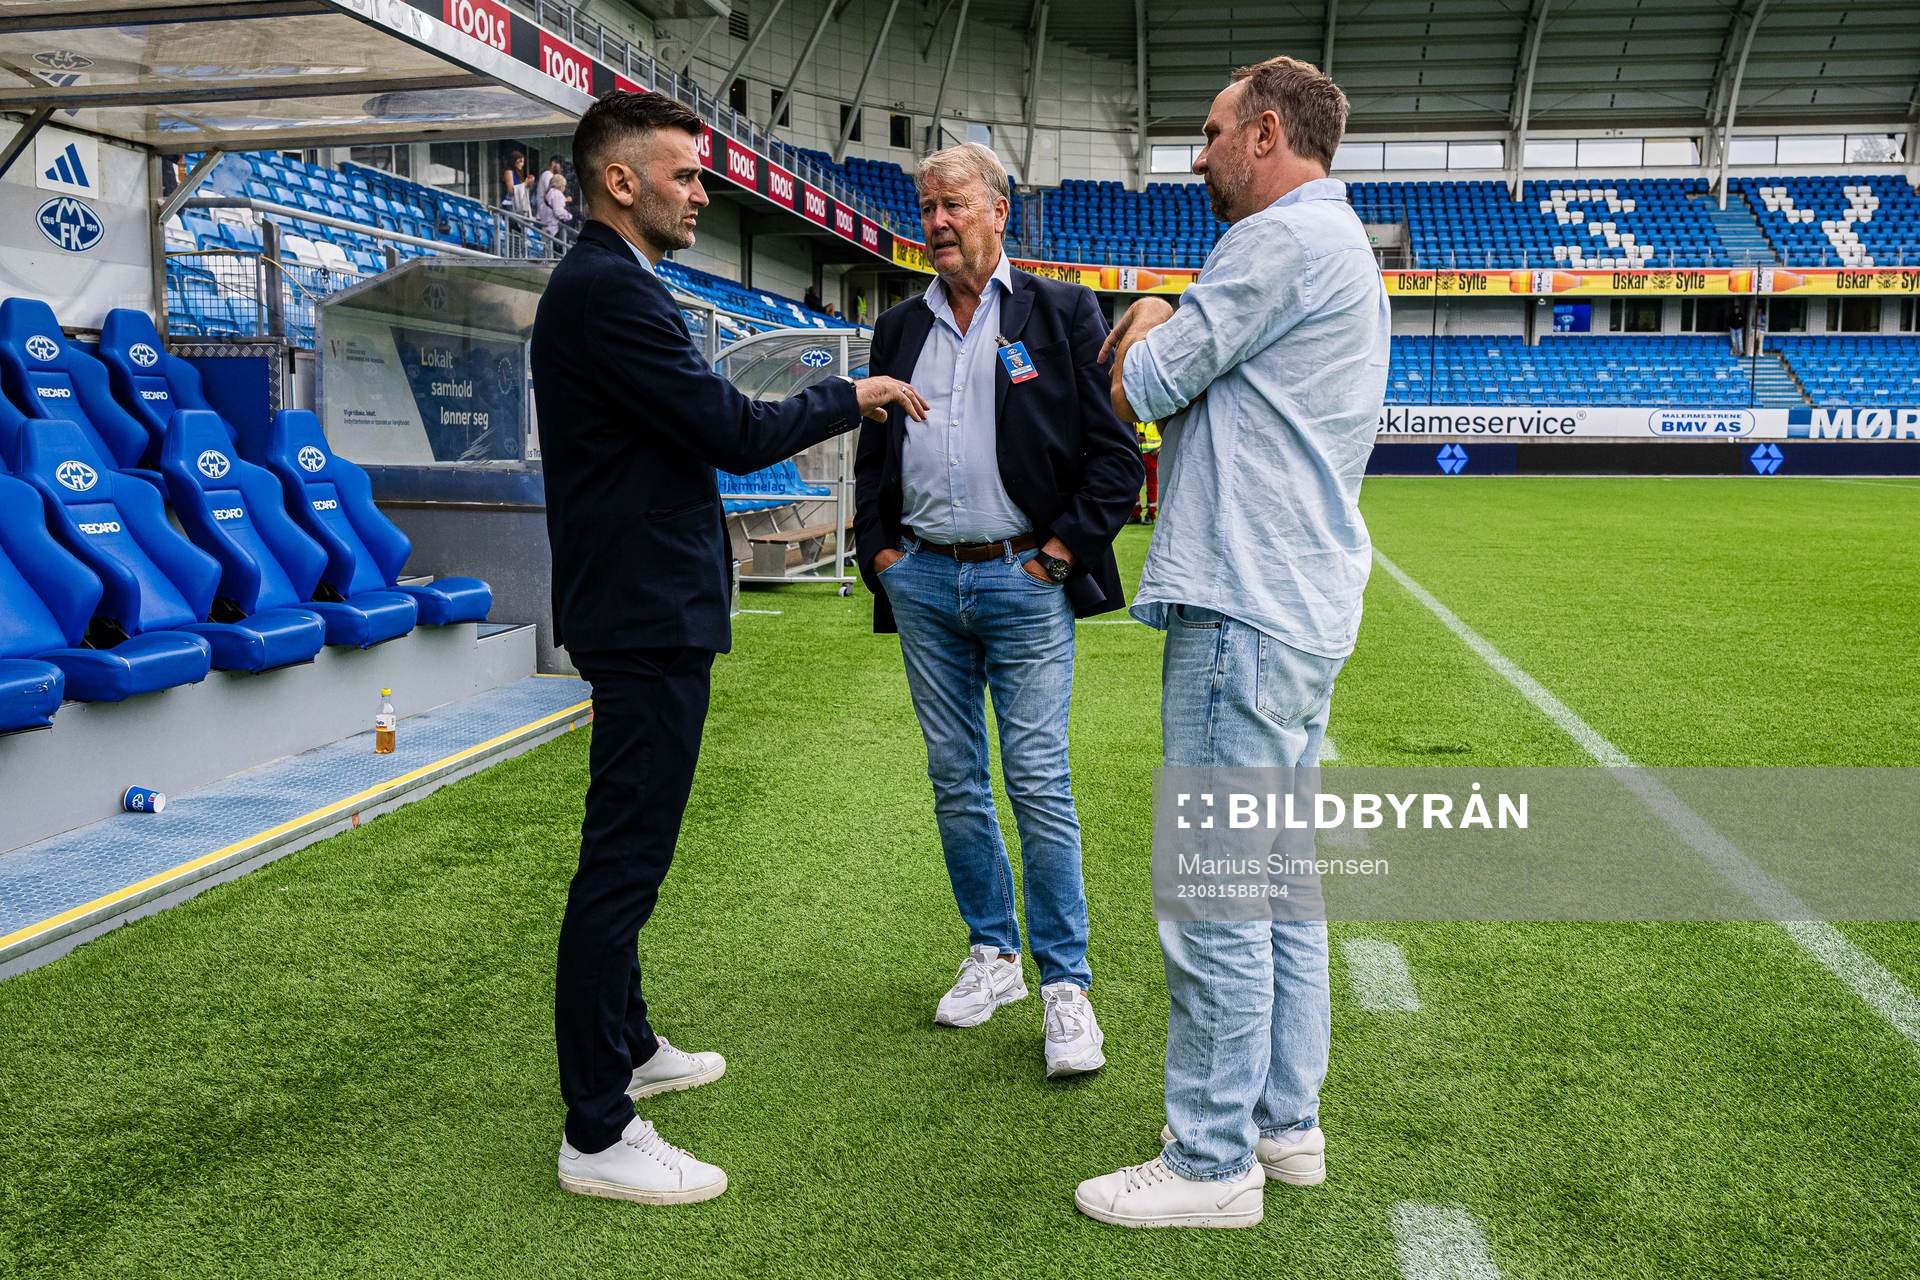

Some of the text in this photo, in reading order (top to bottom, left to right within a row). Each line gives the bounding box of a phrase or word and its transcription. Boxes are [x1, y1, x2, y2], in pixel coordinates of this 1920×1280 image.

[450, 0, 506, 50] TOOLS
[543, 45, 589, 94] TOOLS
[729, 149, 755, 181] TOOLS
[770, 172, 792, 201] TOOLS
[806, 191, 825, 218] TOOLS
[836, 209, 853, 230] TOOLS
[862, 224, 878, 246] TOOLS
[1058, 266, 1080, 284] Sylte
[1399, 273, 1432, 290] Oskar
[1459, 273, 1487, 293] Sylte
[1613, 272, 1648, 290] Oskar
[1676, 272, 1705, 292] Sylte
[1836, 272, 1873, 290] Oskar
[421, 347, 454, 369] Lokalt
[37, 387, 70, 398] RECARO
[431, 380, 472, 398] samhold
[440, 406, 489, 430] lønner seg
[1662, 421, 1741, 432] BMV AS
[1809, 408, 1920, 439] MØR
[720, 480, 786, 494] Hjemmelag
[312, 500, 337, 511] ECARO
[79, 521, 120, 535] RECARO
